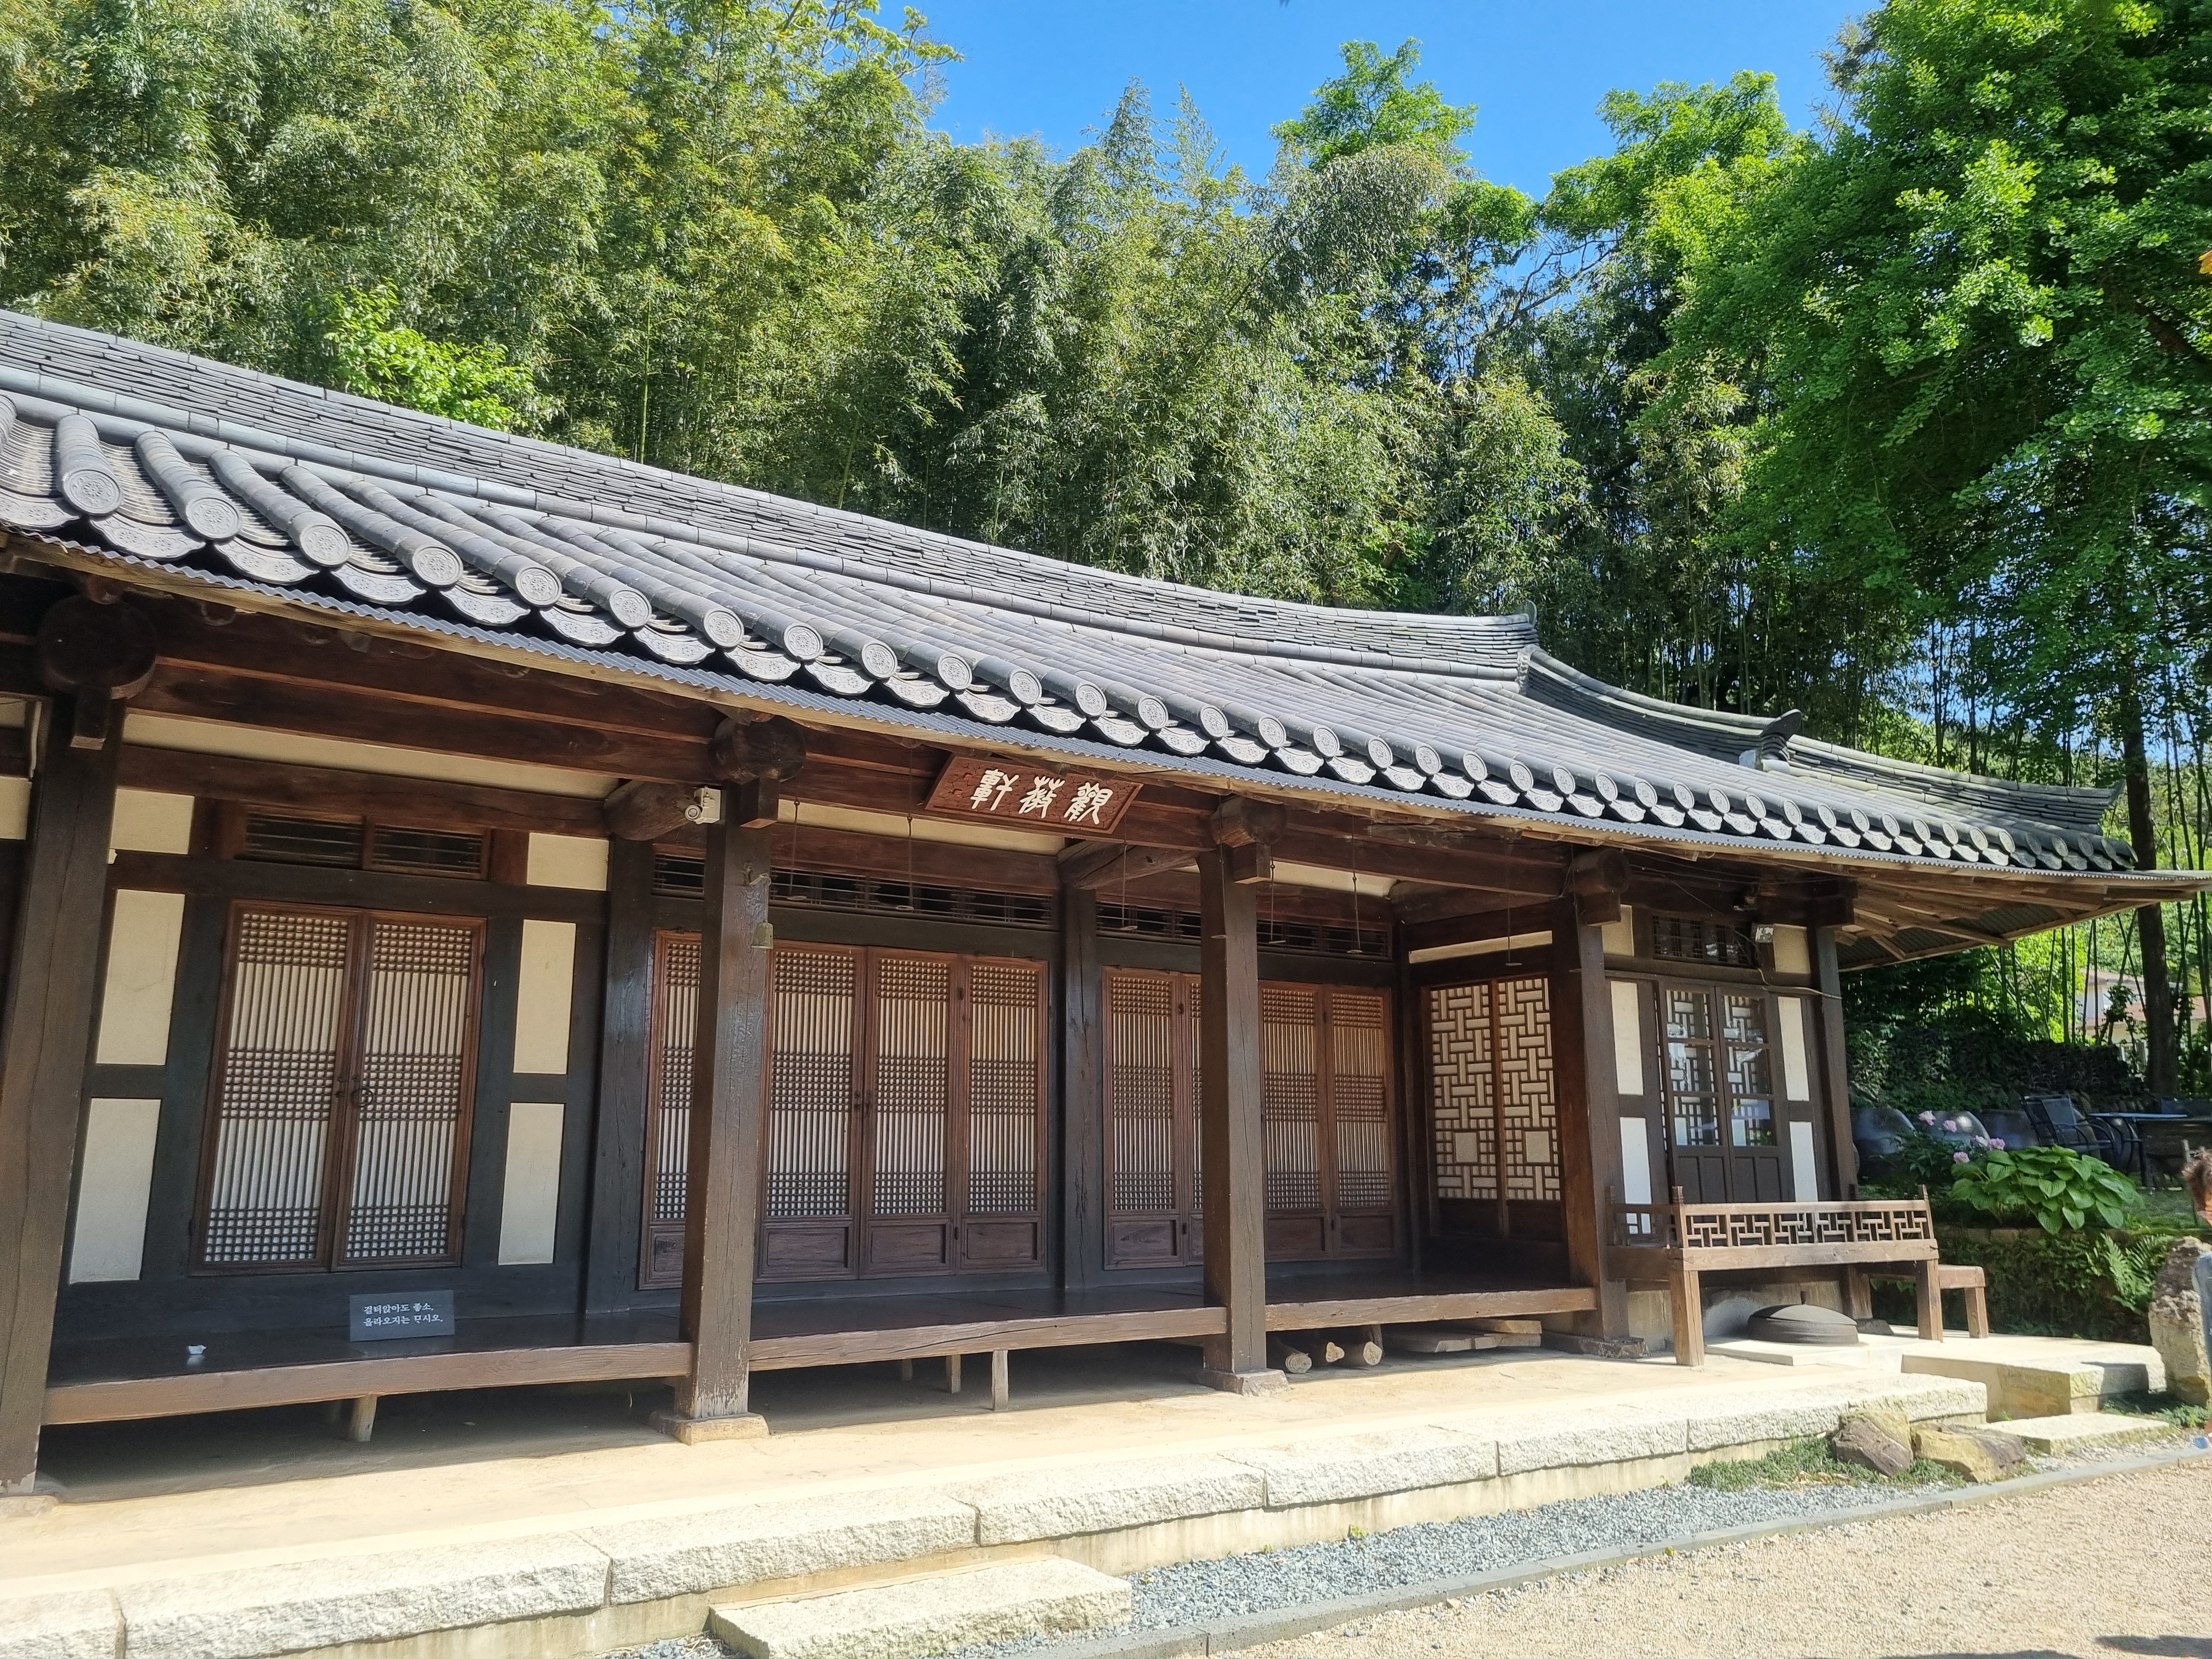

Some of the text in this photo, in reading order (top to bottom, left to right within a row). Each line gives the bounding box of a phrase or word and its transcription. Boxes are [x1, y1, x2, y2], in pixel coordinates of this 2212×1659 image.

[364, 1302, 434, 1314] 걸터앉아도 좋소.
[363, 1316, 410, 1327] 올라오지는
